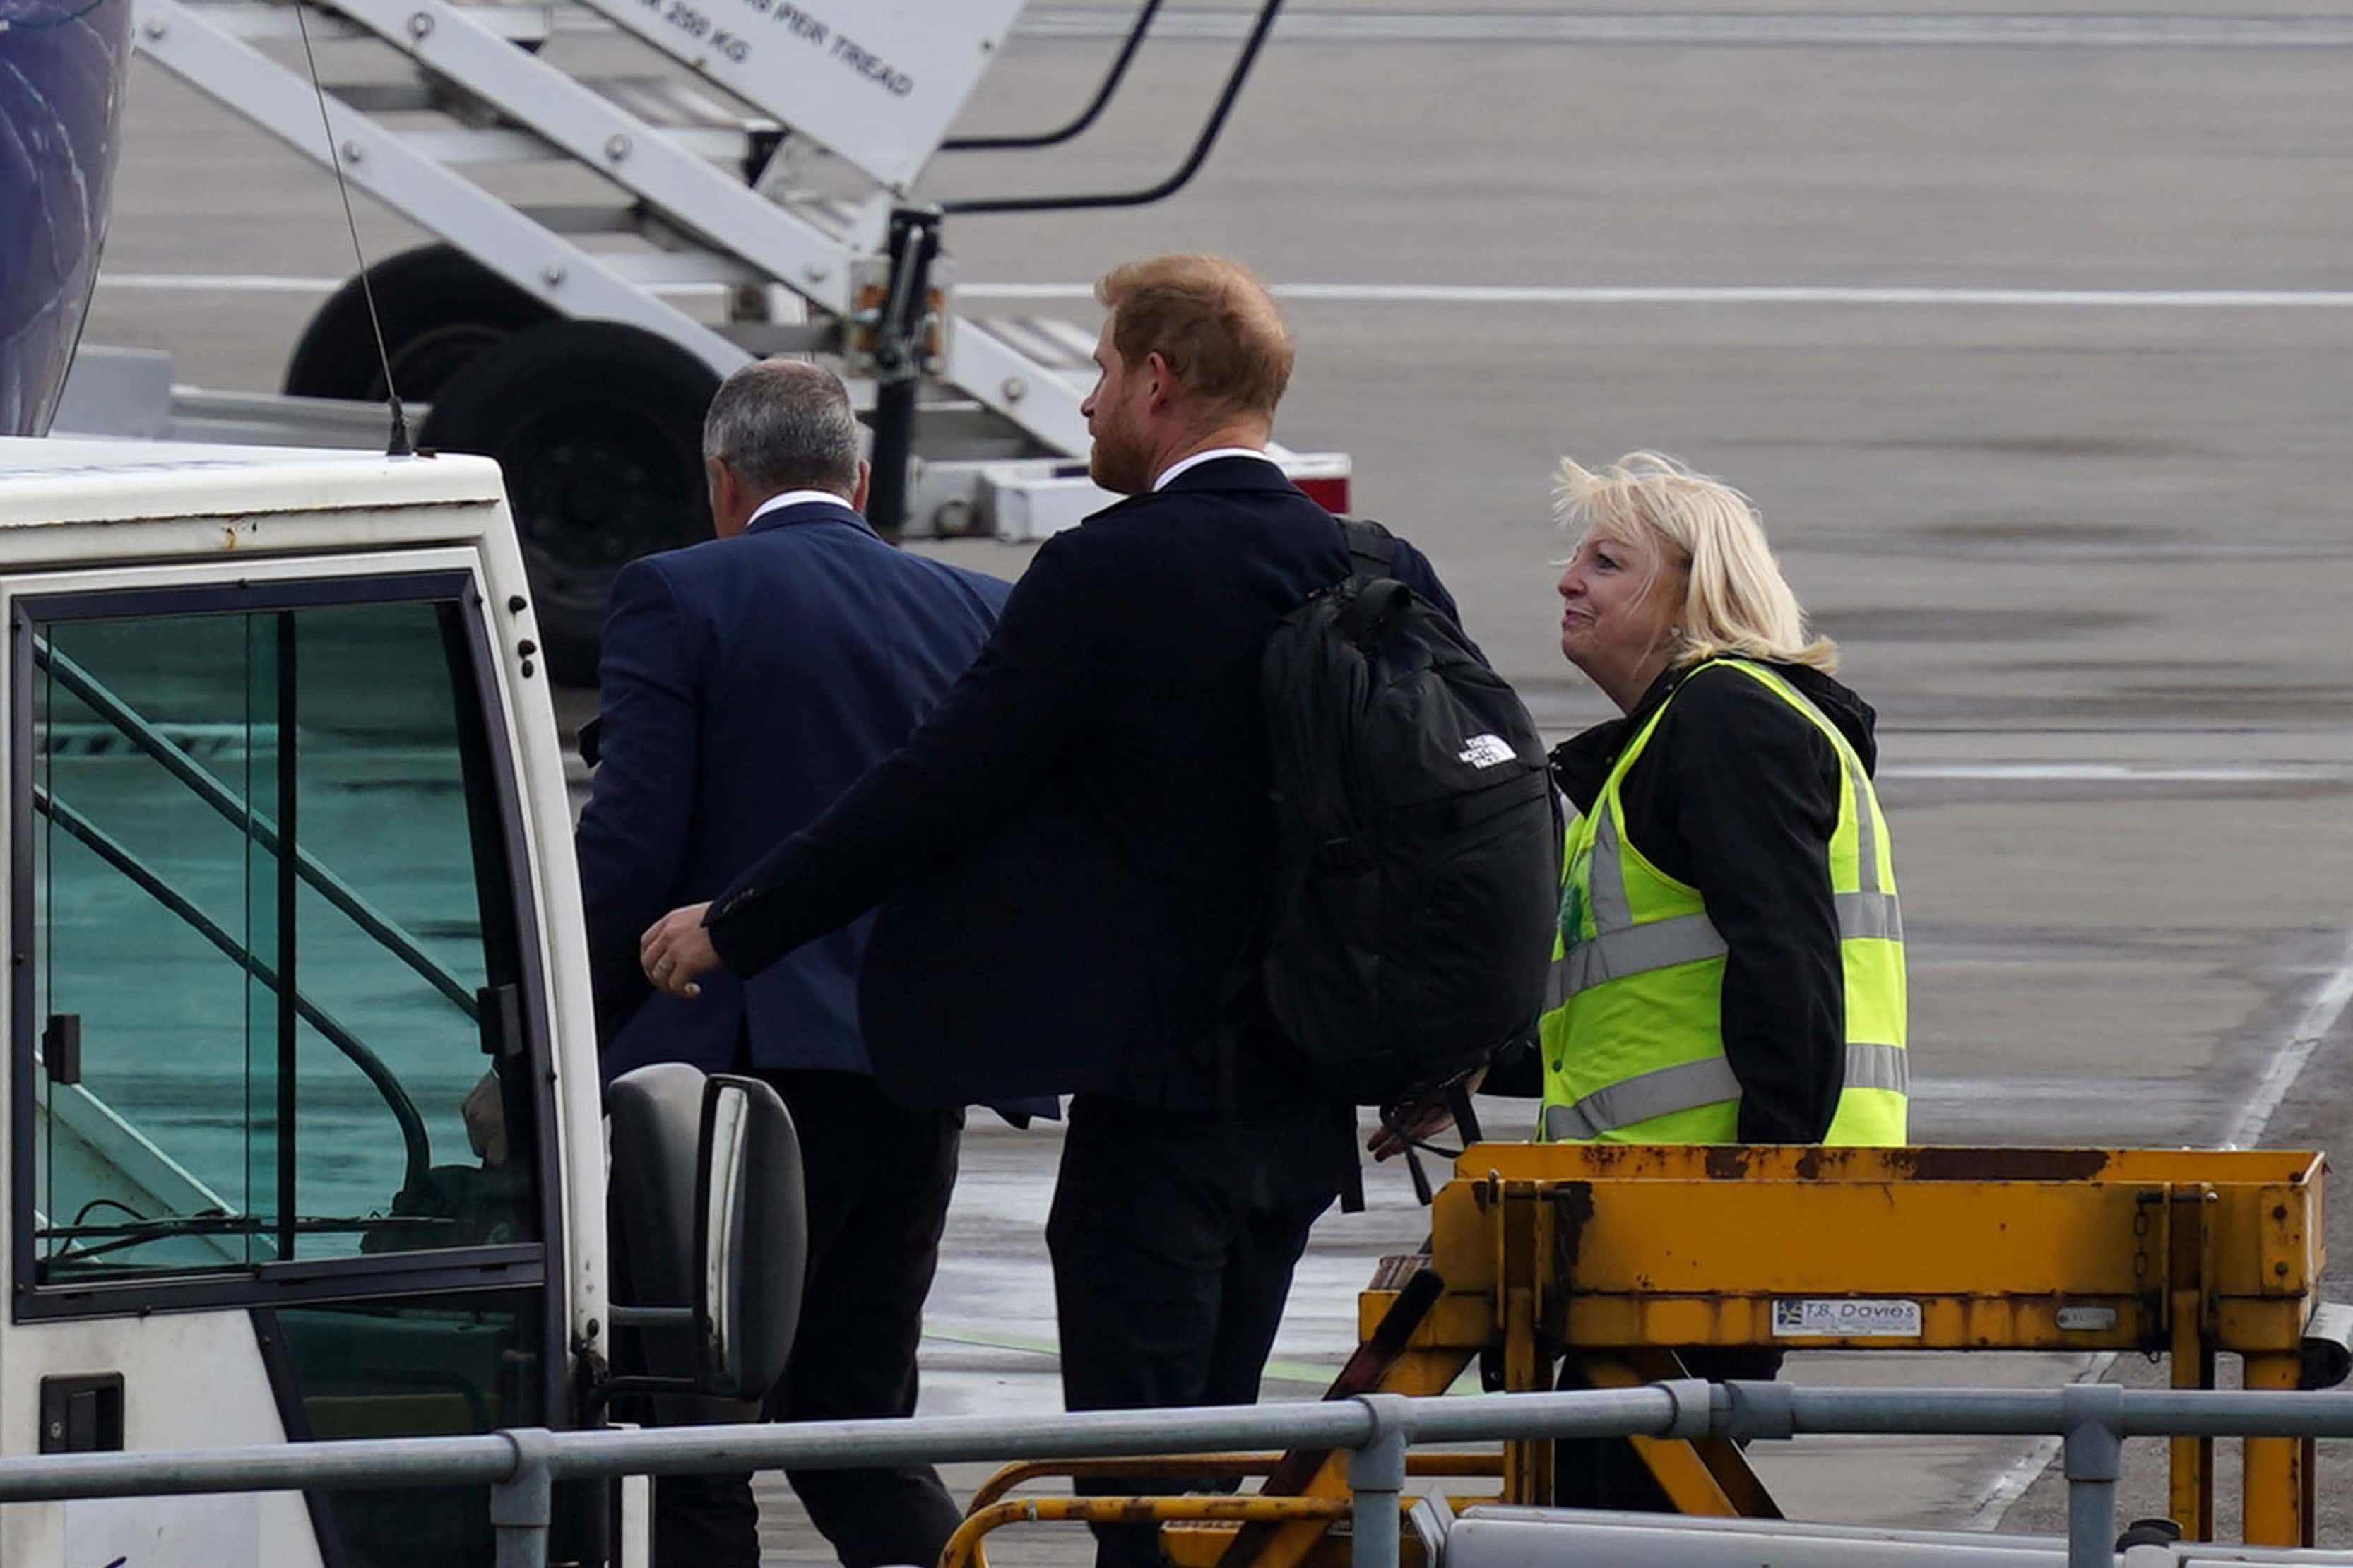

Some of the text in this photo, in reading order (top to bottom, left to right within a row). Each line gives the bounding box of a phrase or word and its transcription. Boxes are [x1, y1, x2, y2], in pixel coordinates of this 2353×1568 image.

[709, 29, 752, 64] KG
[773, 1, 914, 97] PER TREAD
[1841, 1304, 1915, 1318] Davies
